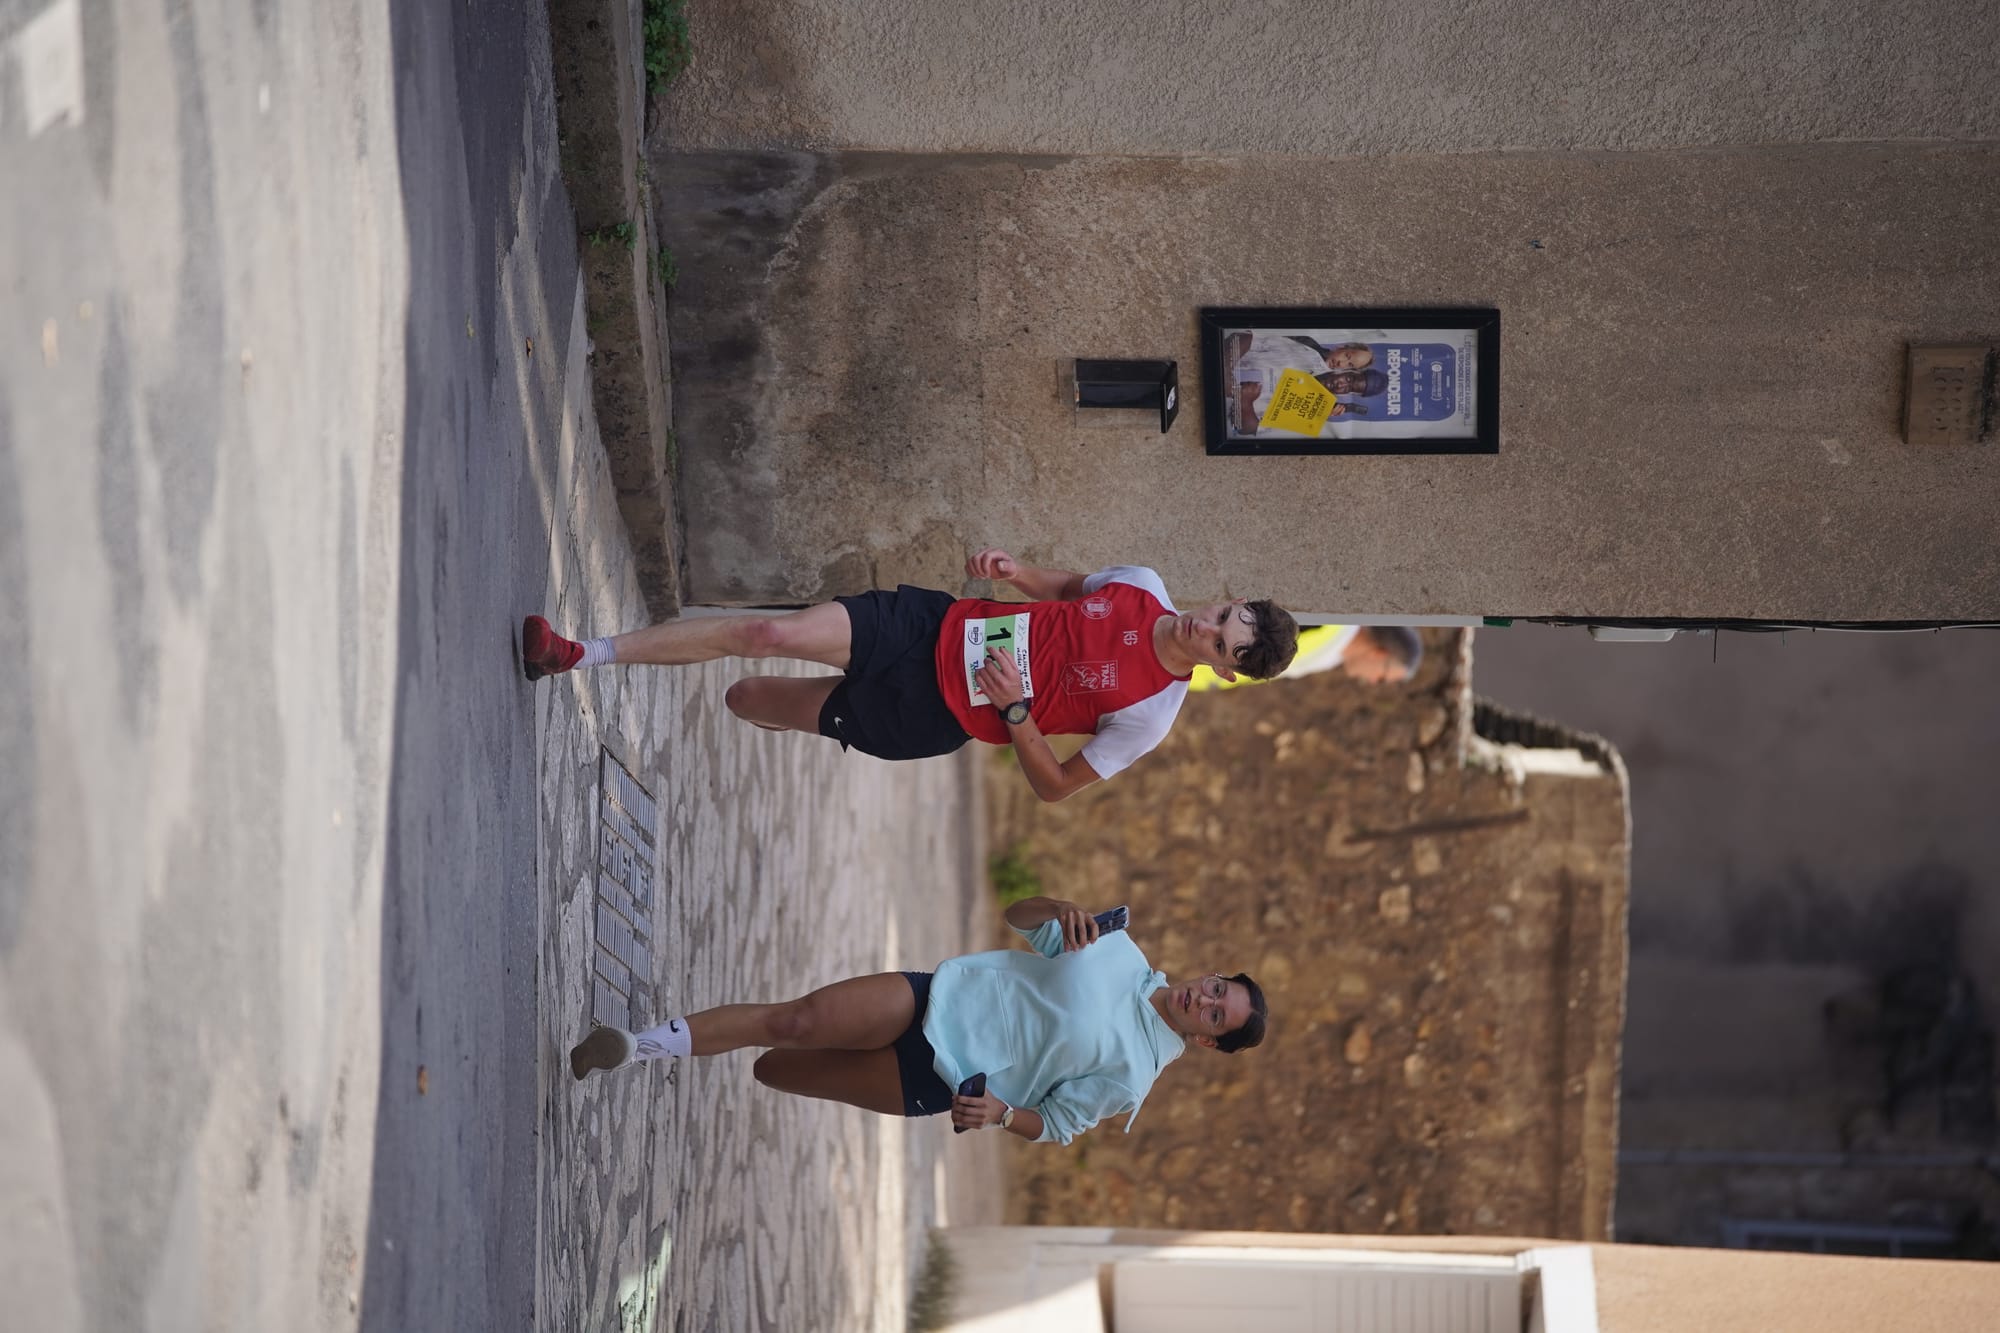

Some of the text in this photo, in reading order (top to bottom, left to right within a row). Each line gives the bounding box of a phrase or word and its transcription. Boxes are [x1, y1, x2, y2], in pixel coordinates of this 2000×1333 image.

[1388, 349, 1402, 415] RÉPONDEUR
[1283, 393, 1296, 411] 21H00
[1293, 397, 1304, 410] 2025
[1297, 400, 1311, 418] AOÛT
[1308, 393, 1324, 420] MERCREDI
[1101, 664, 1110, 688] TRAIL
